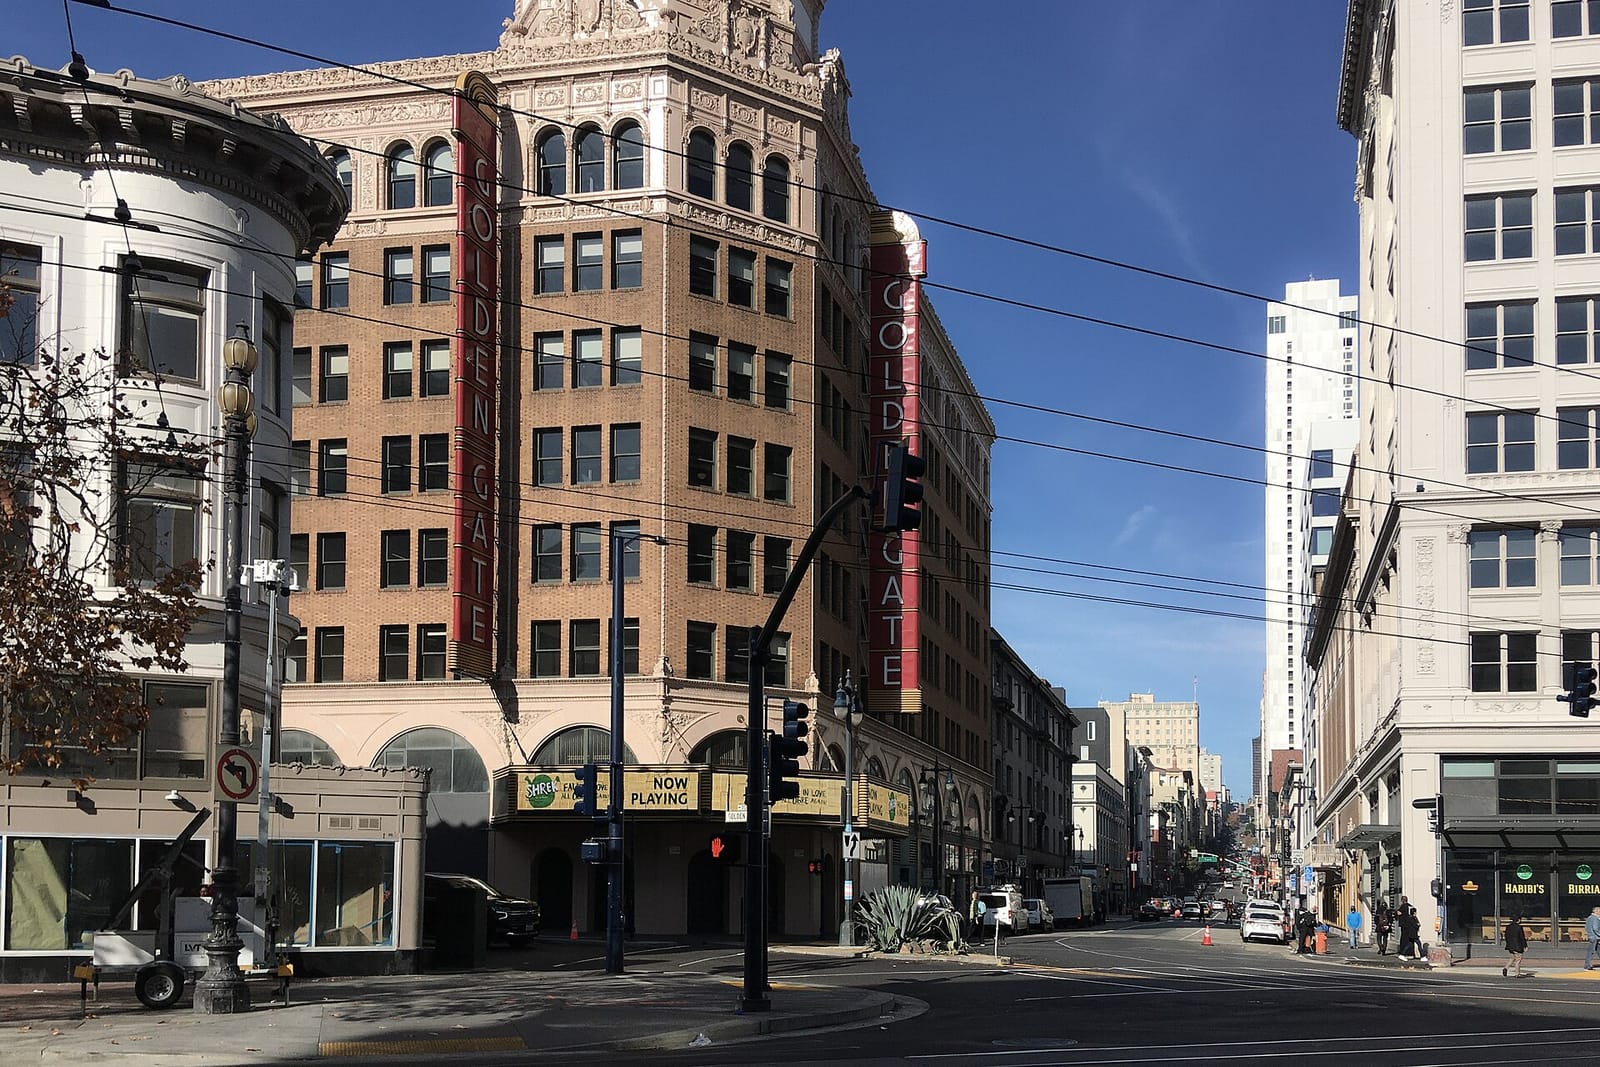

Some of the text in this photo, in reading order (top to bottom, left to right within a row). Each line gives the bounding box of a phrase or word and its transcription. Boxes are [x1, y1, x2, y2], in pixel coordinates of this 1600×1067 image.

[471, 157, 493, 644] GOLDEN GATE
[879, 281, 908, 685] GOLD GATE
[525, 780, 559, 799] SHREK
[654, 777, 688, 790] NOW
[631, 792, 688, 805] PLAYING
[1505, 883, 1545, 894] HABIBI'S
[1568, 883, 1600, 894] BIRRIA
